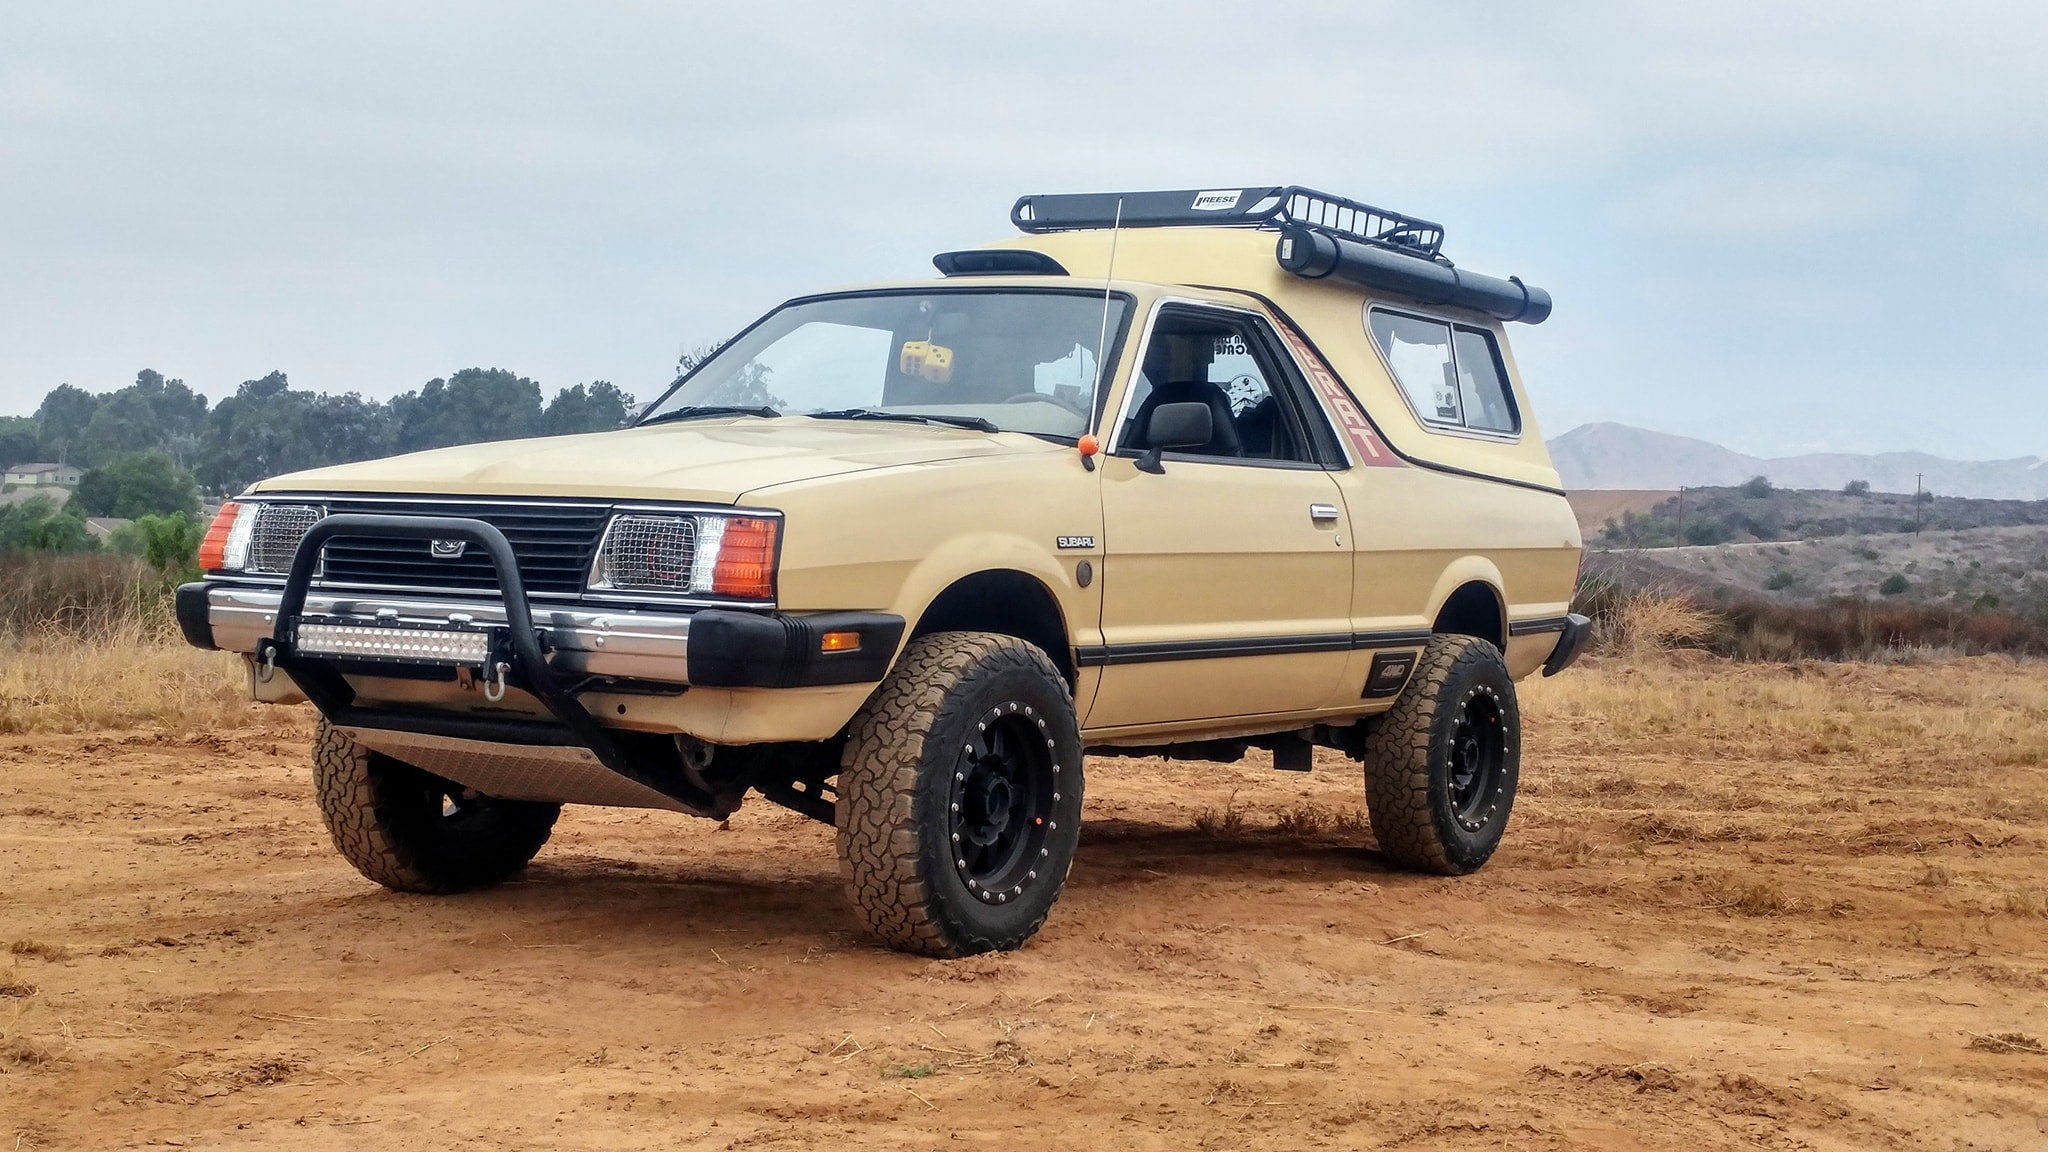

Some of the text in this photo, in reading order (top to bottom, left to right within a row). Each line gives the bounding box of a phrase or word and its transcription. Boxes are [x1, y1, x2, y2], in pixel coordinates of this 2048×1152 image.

[1202, 196, 1236, 204] REESE
[1296, 346, 1380, 458] BRAT
[1058, 537, 1095, 547] SUBARU
